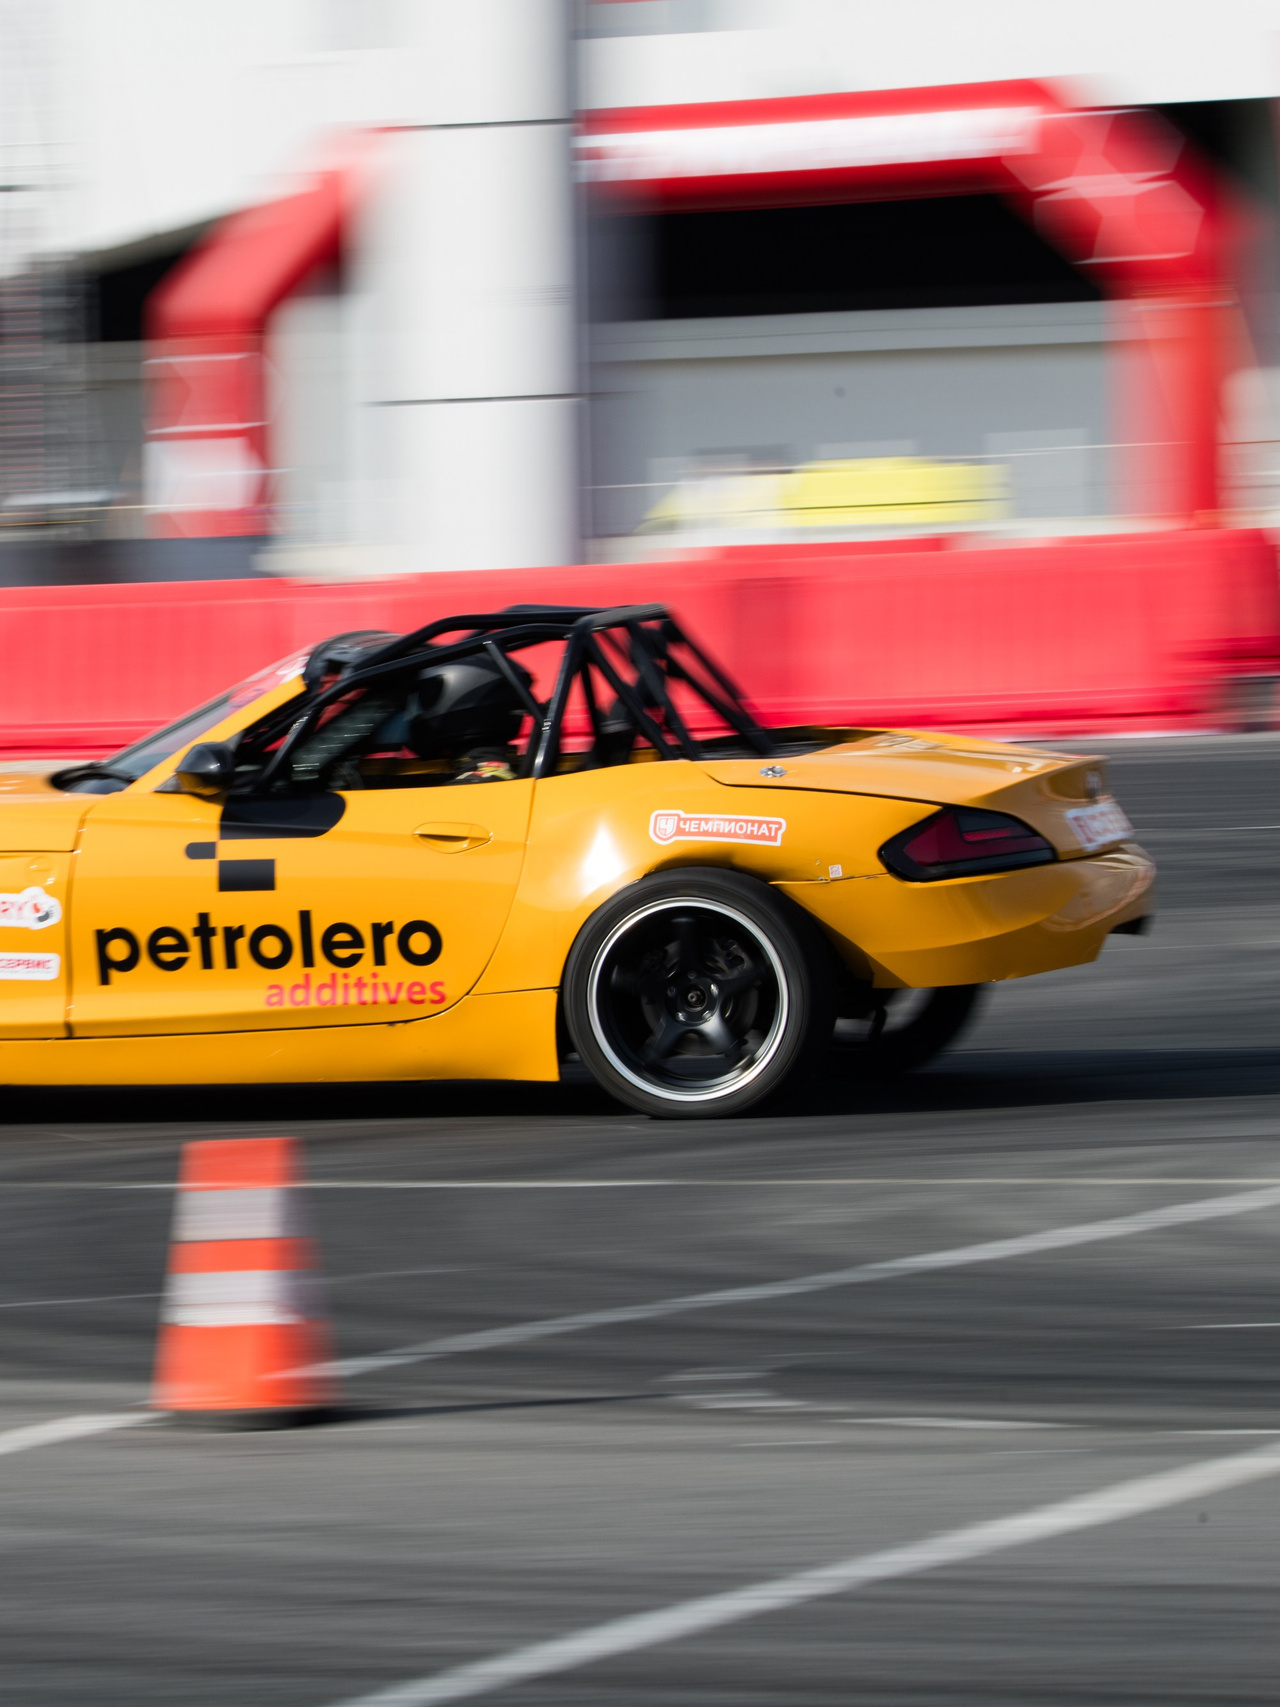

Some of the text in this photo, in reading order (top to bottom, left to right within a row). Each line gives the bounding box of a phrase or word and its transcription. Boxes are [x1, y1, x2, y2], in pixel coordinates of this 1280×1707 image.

[679, 820, 779, 837] ЧЕМПИОНАТ
[94, 909, 443, 985] petrolero
[264, 971, 447, 1007] additives
